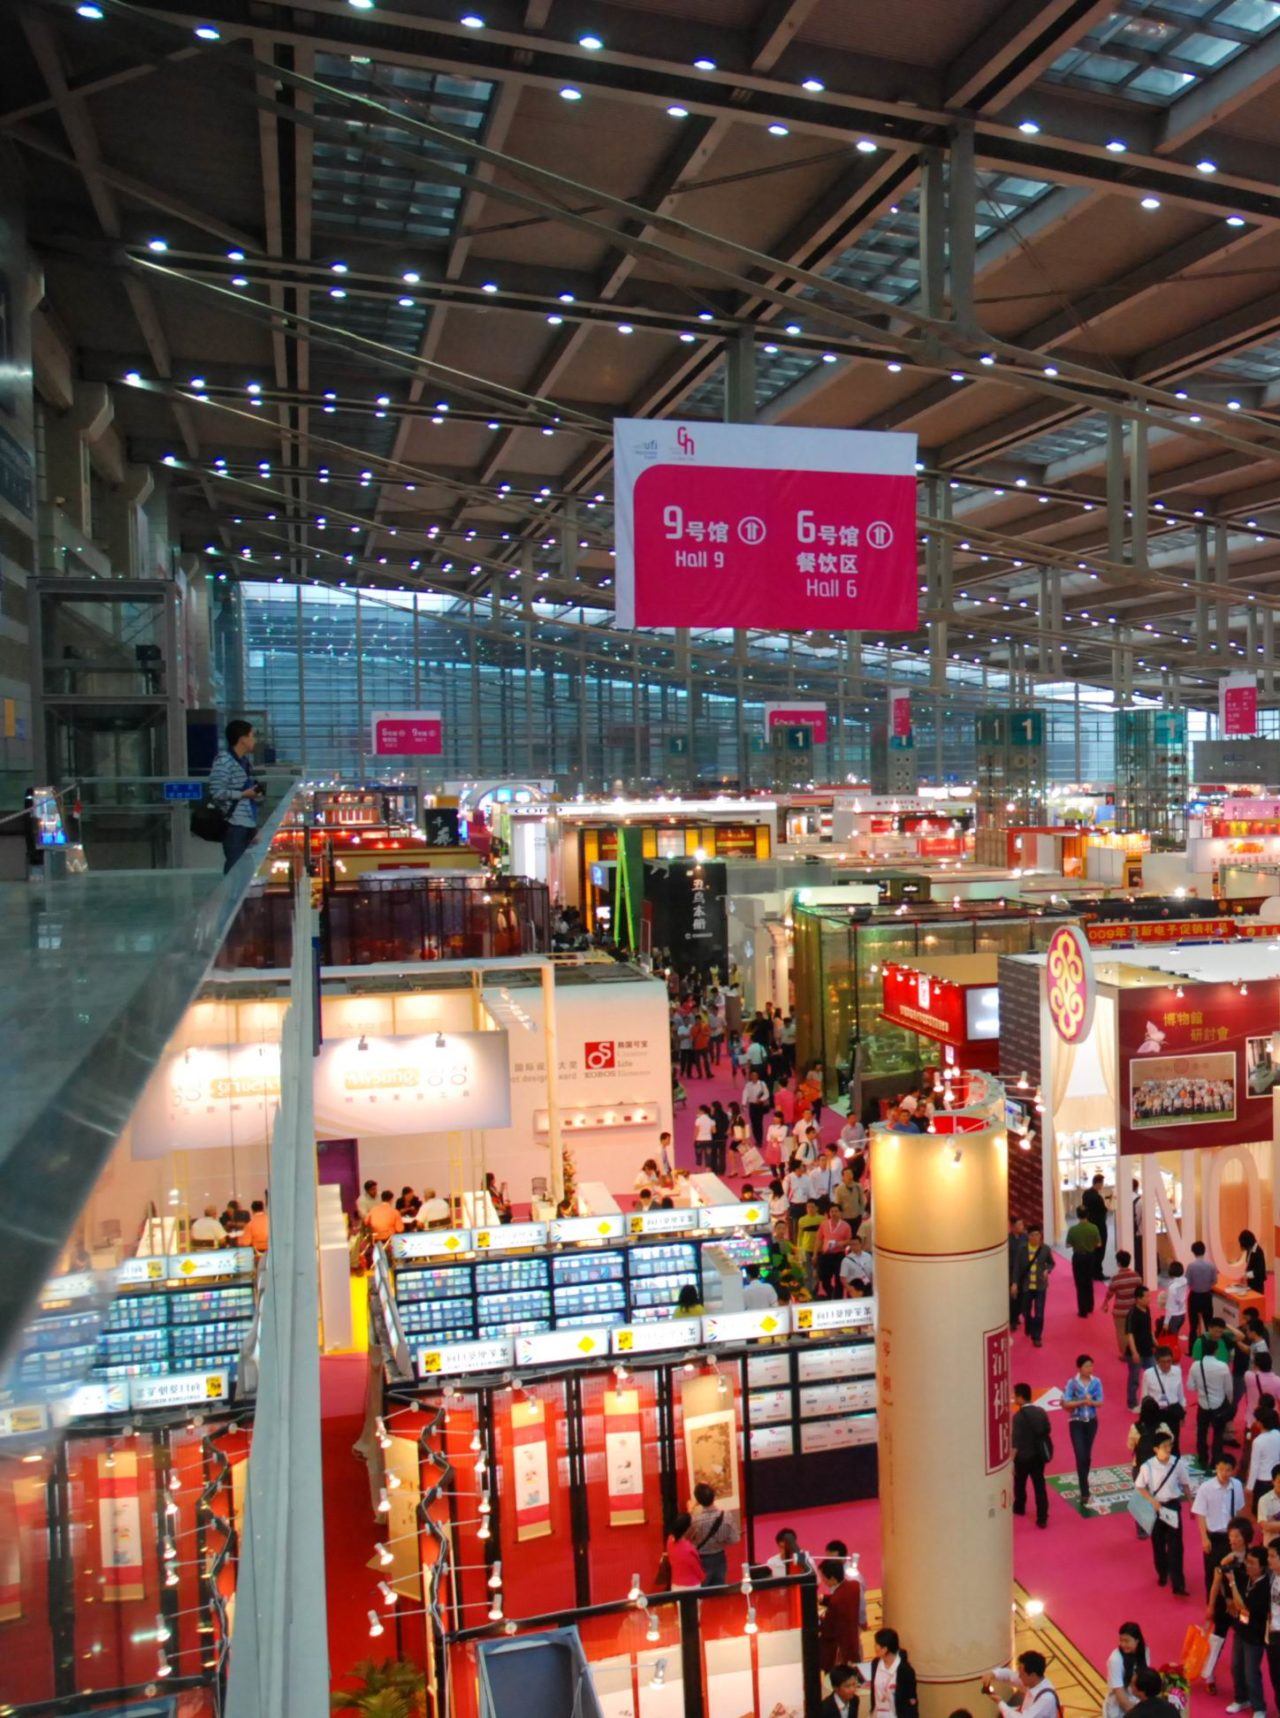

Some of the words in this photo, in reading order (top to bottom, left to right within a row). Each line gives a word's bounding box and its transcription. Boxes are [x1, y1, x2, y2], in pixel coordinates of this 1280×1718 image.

[663, 505, 729, 544] 9号馆
[797, 510, 860, 547] 6号馆
[675, 551, 707, 568] Hall
[714, 552, 725, 568] 9
[796, 553, 859, 575] 餐饮区
[806, 579, 840, 598] Hall
[846, 579, 858, 599] 6
[558, 1073, 578, 1081] ward
